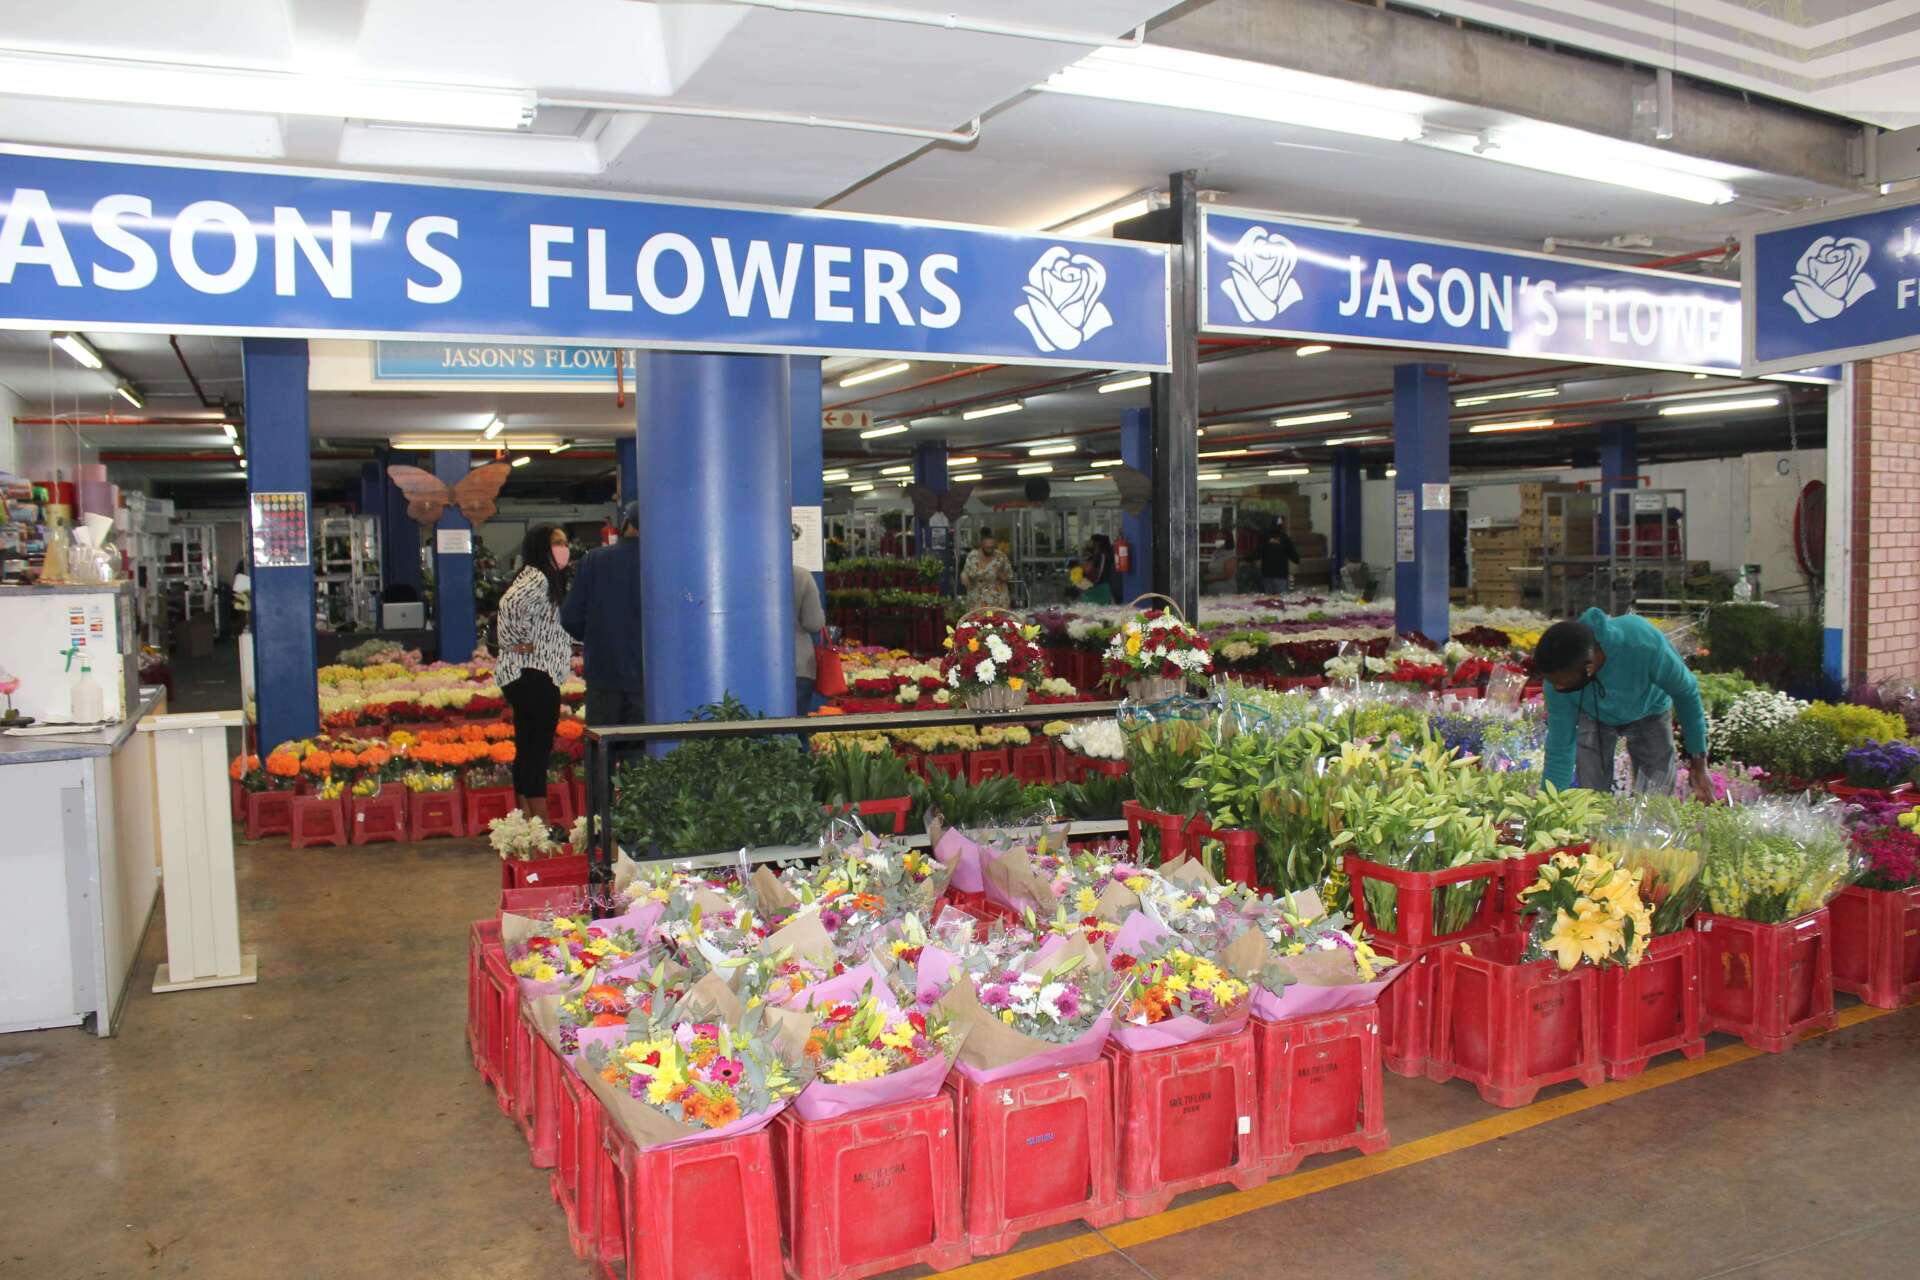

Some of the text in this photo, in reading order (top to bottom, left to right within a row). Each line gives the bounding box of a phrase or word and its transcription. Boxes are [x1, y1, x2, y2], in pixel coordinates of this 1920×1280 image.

[529, 223, 963, 330] FLOWERS
[1338, 255, 1558, 337] JASON'S
[441, 347, 535, 369] JASON'S
